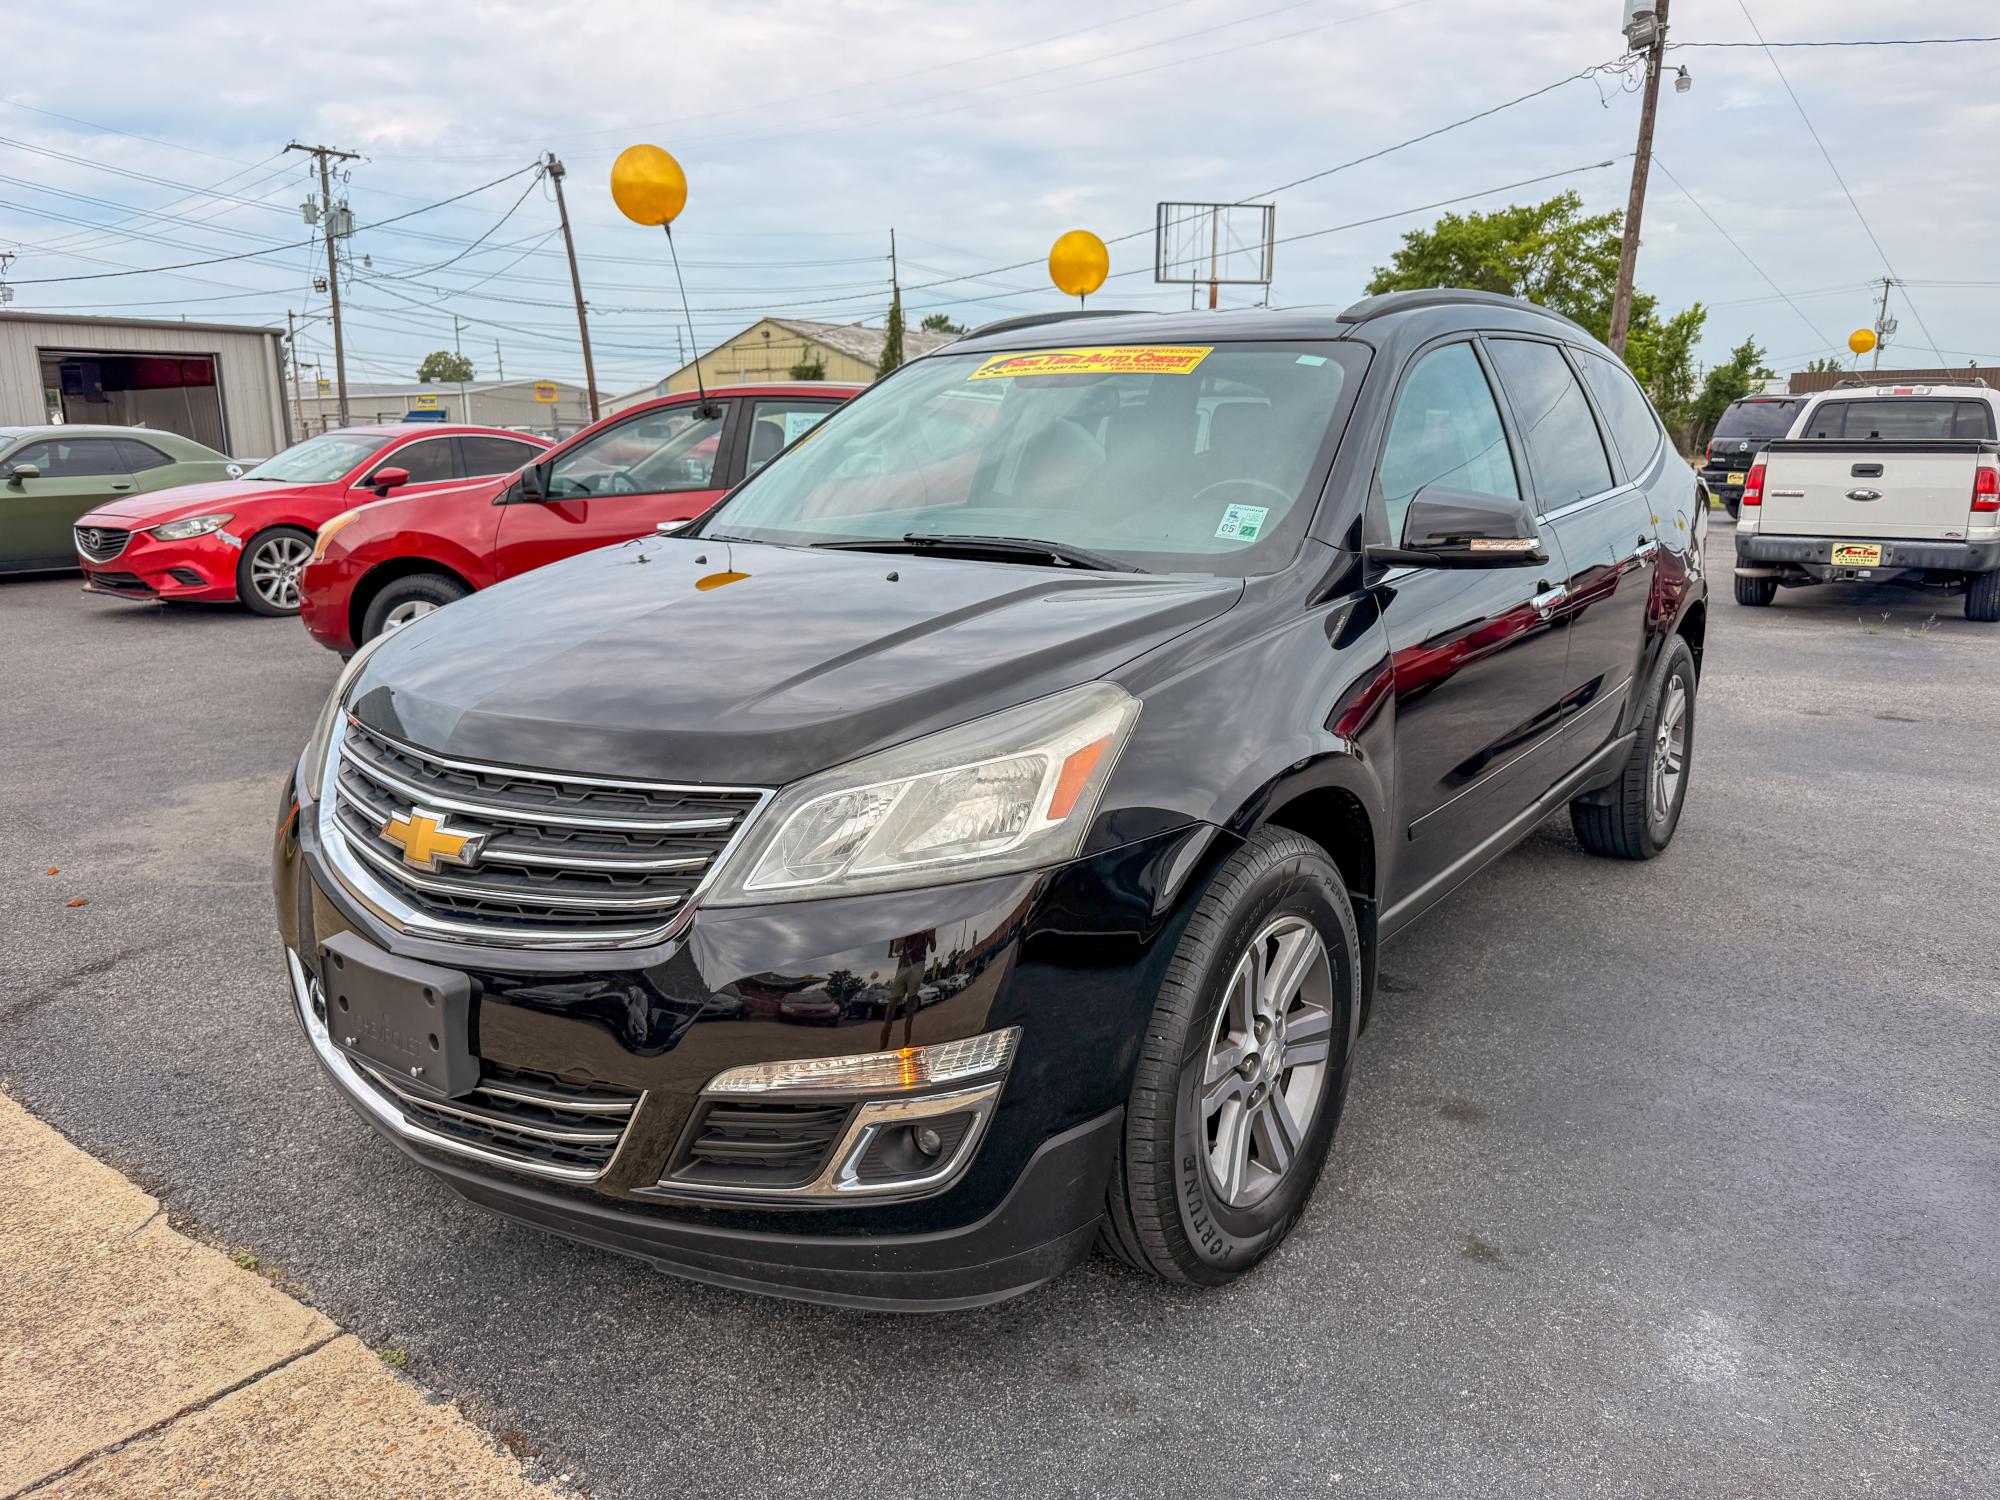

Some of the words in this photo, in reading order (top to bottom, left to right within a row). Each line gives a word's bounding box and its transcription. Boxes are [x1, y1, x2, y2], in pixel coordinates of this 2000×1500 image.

[1085, 353, 1131, 364] AUTO
[1132, 353, 1200, 364] CREDIT
[1221, 523, 1236, 533] 05
[1241, 526, 1256, 537] 27
[1323, 876, 1360, 961] PERFECTUS
[1182, 1153, 1235, 1263] FORTUNE
